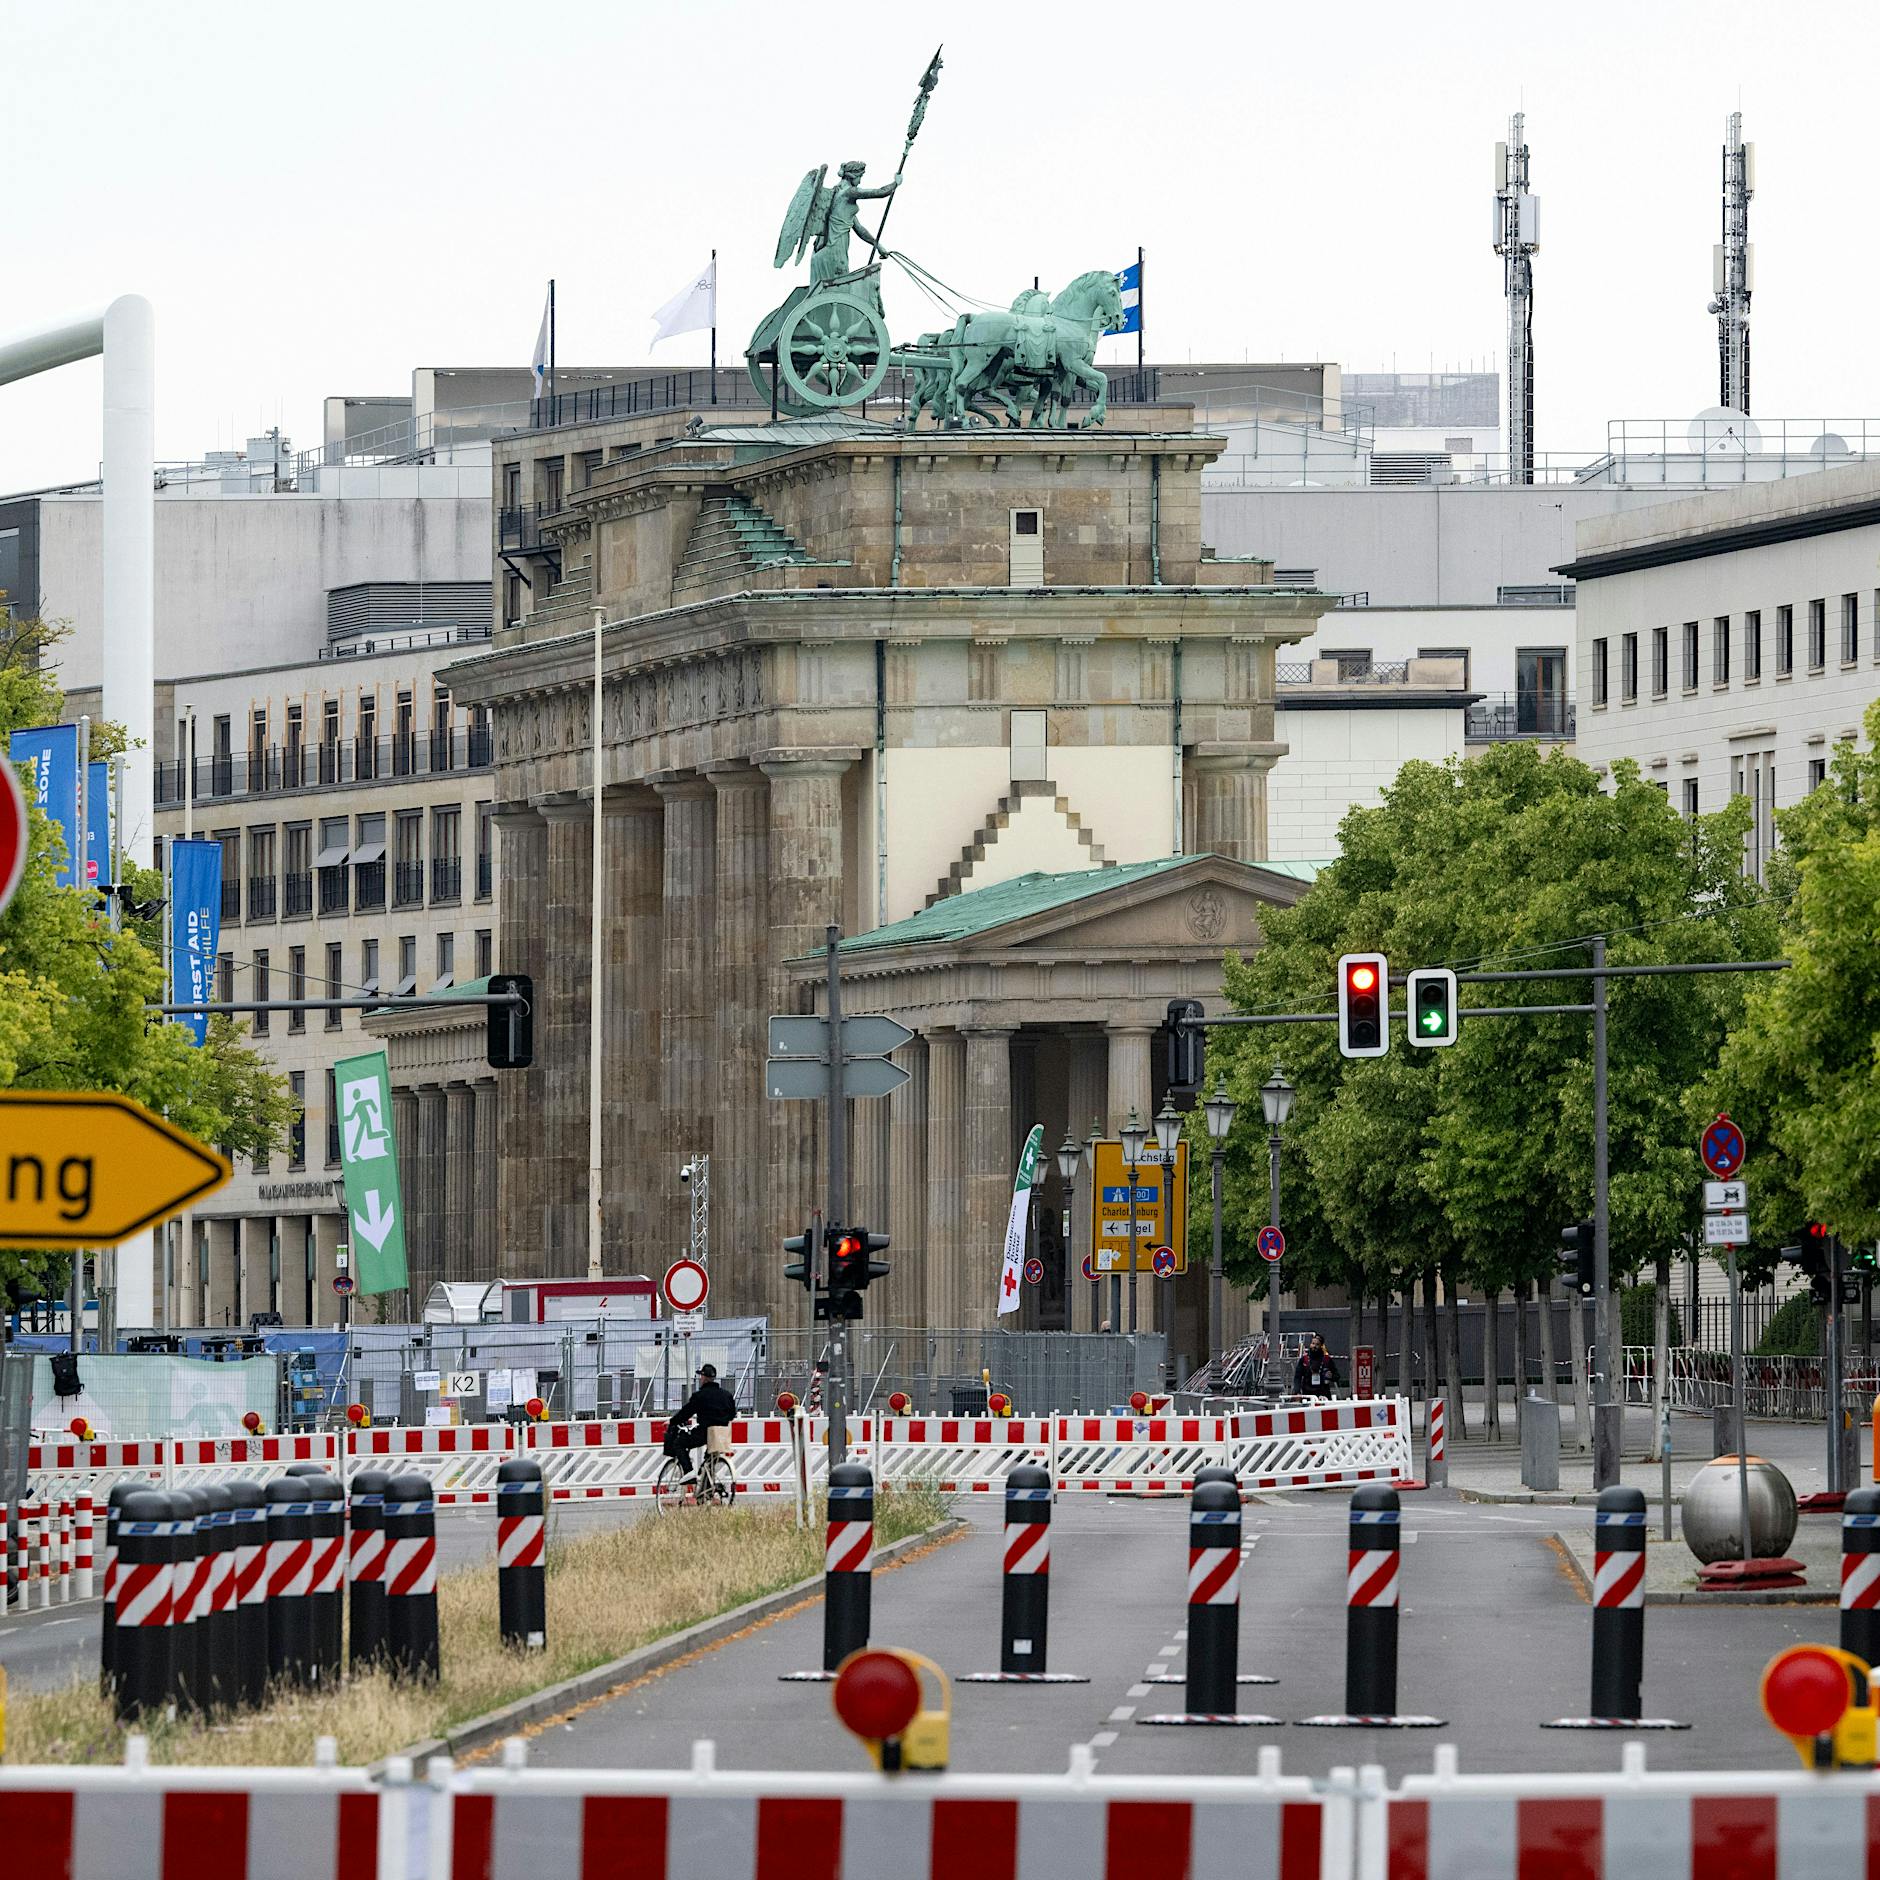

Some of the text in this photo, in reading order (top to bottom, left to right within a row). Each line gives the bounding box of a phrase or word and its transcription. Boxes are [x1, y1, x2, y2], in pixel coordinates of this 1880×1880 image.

[188, 911, 199, 951] AID
[200, 907, 213, 959] HILFE
[1006, 1204, 1017, 1260] Deutsches
[1124, 1223, 1151, 1235] Tgel
[452, 1376, 474, 1393] K2
